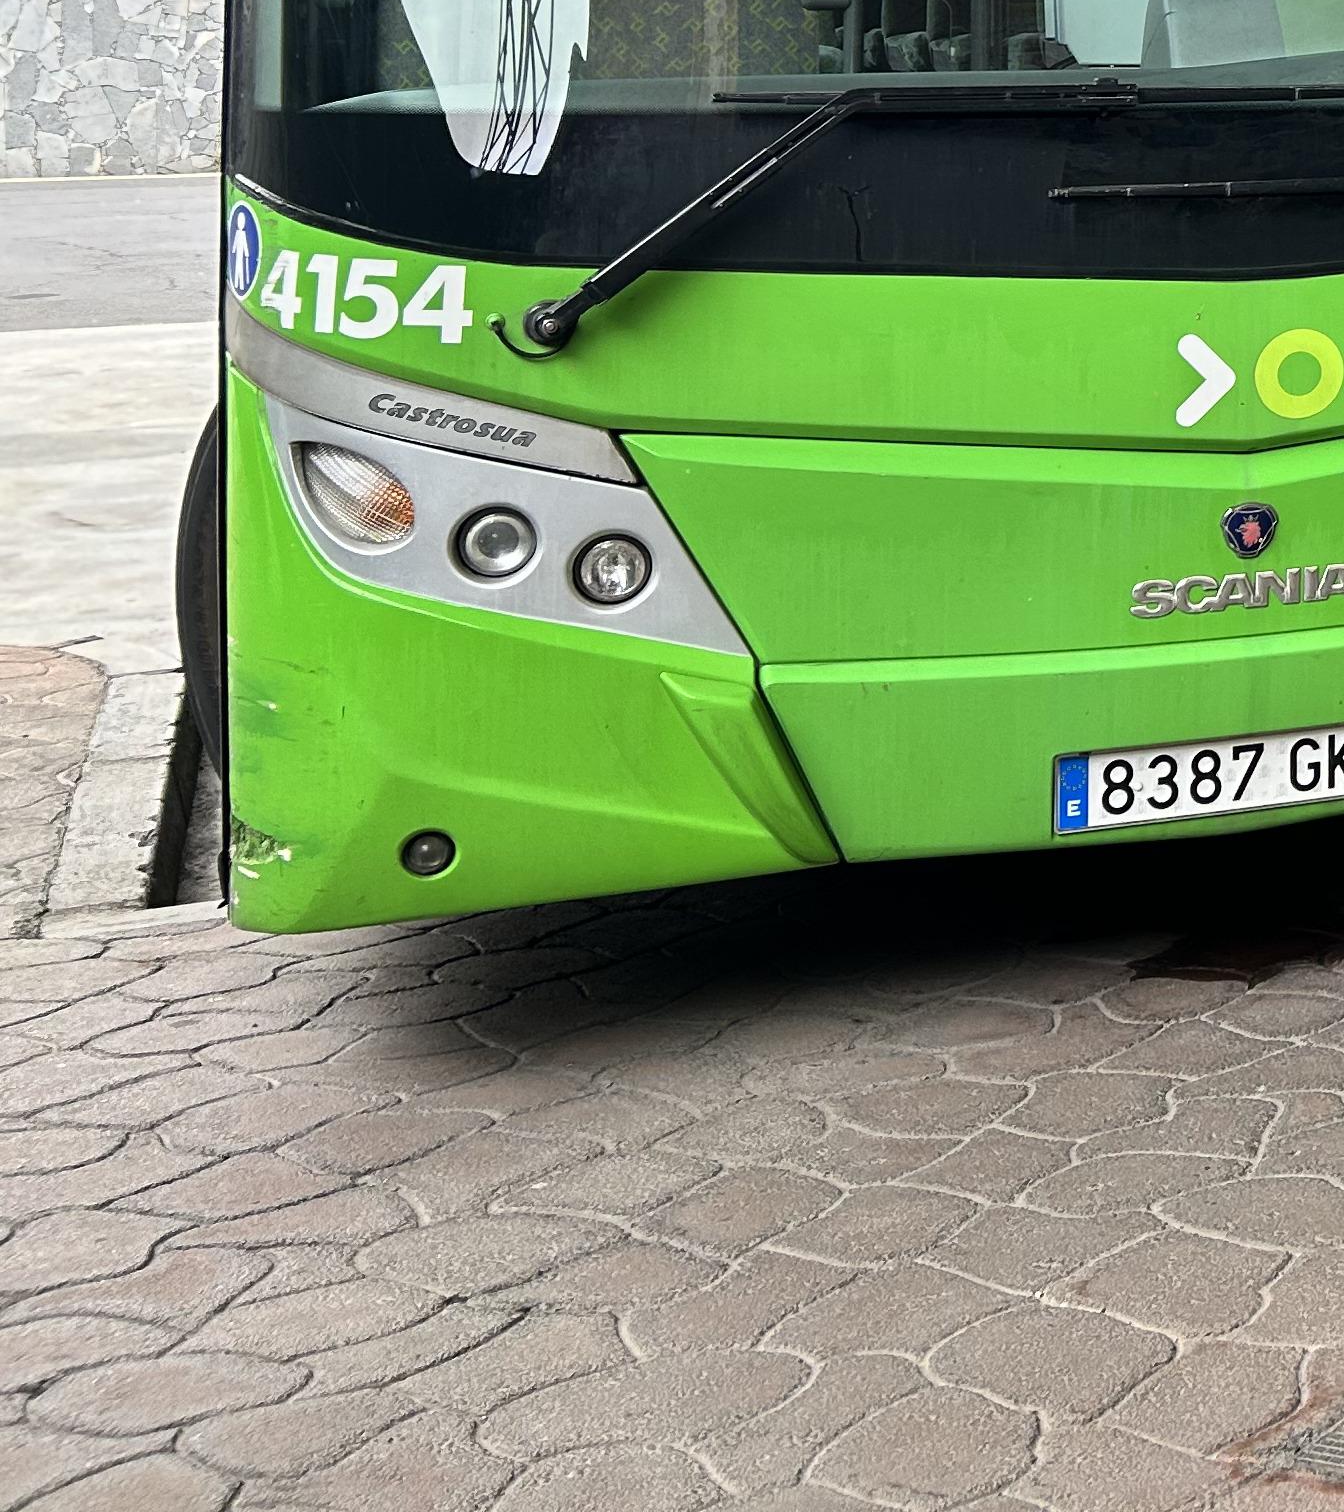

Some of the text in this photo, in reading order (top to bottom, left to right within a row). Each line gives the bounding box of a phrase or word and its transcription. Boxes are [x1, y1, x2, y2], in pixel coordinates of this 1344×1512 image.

[261, 249, 473, 344] 4154
[368, 392, 538, 449] Castrosua
[1066, 799, 1082, 818] E
[1101, 743, 1265, 815] 8387
